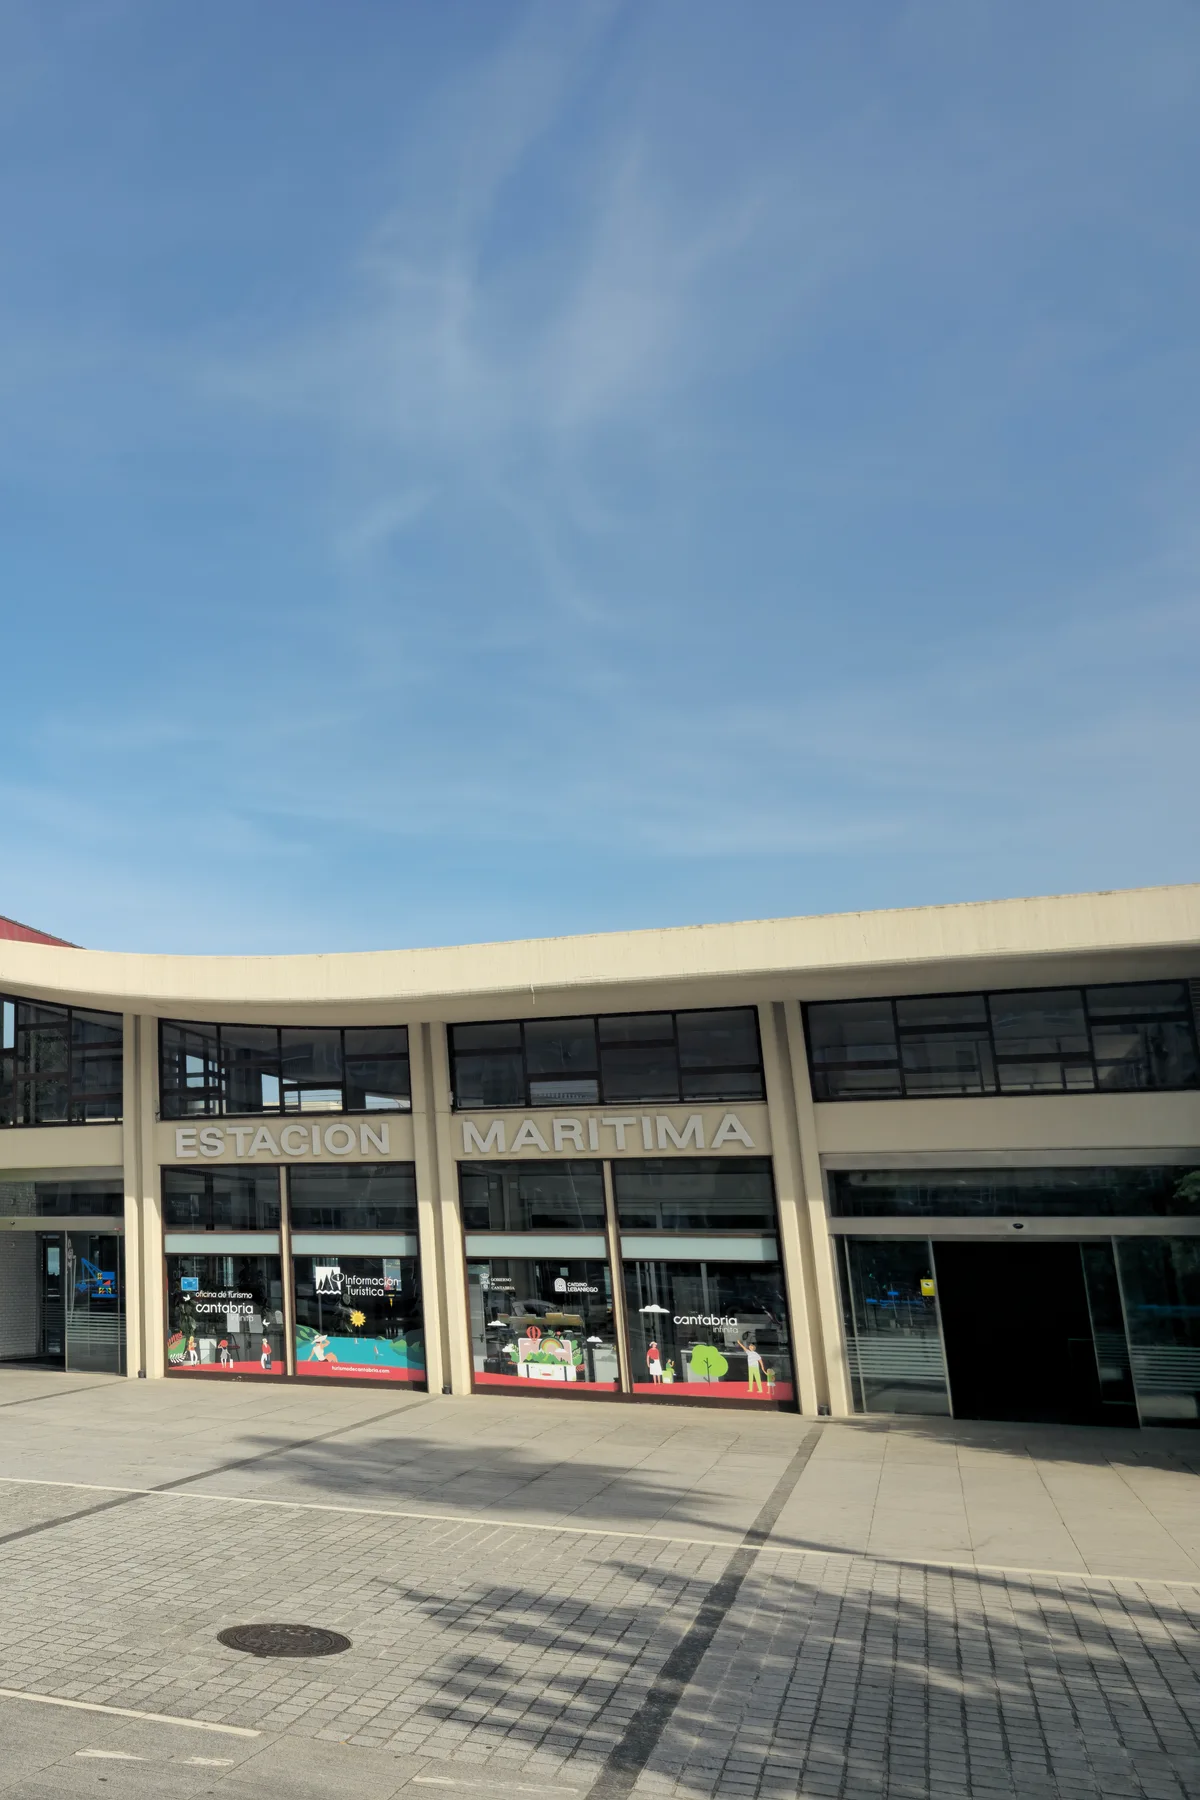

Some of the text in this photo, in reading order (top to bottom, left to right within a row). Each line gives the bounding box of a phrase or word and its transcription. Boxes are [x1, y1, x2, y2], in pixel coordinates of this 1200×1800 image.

[462, 1113, 756, 1153] MARITIMA
[175, 1122, 390, 1158] ESTACION
[345, 1274, 399, 1286] Información
[218, 1290, 227, 1299] de
[228, 1291, 253, 1299] Turismo
[346, 1285, 384, 1297] Turística
[195, 1301, 254, 1314] cantabria
[673, 1313, 738, 1326] cantabria
[712, 1326, 739, 1334] infinita
[331, 1365, 390, 1374] turismodecantabria.com
